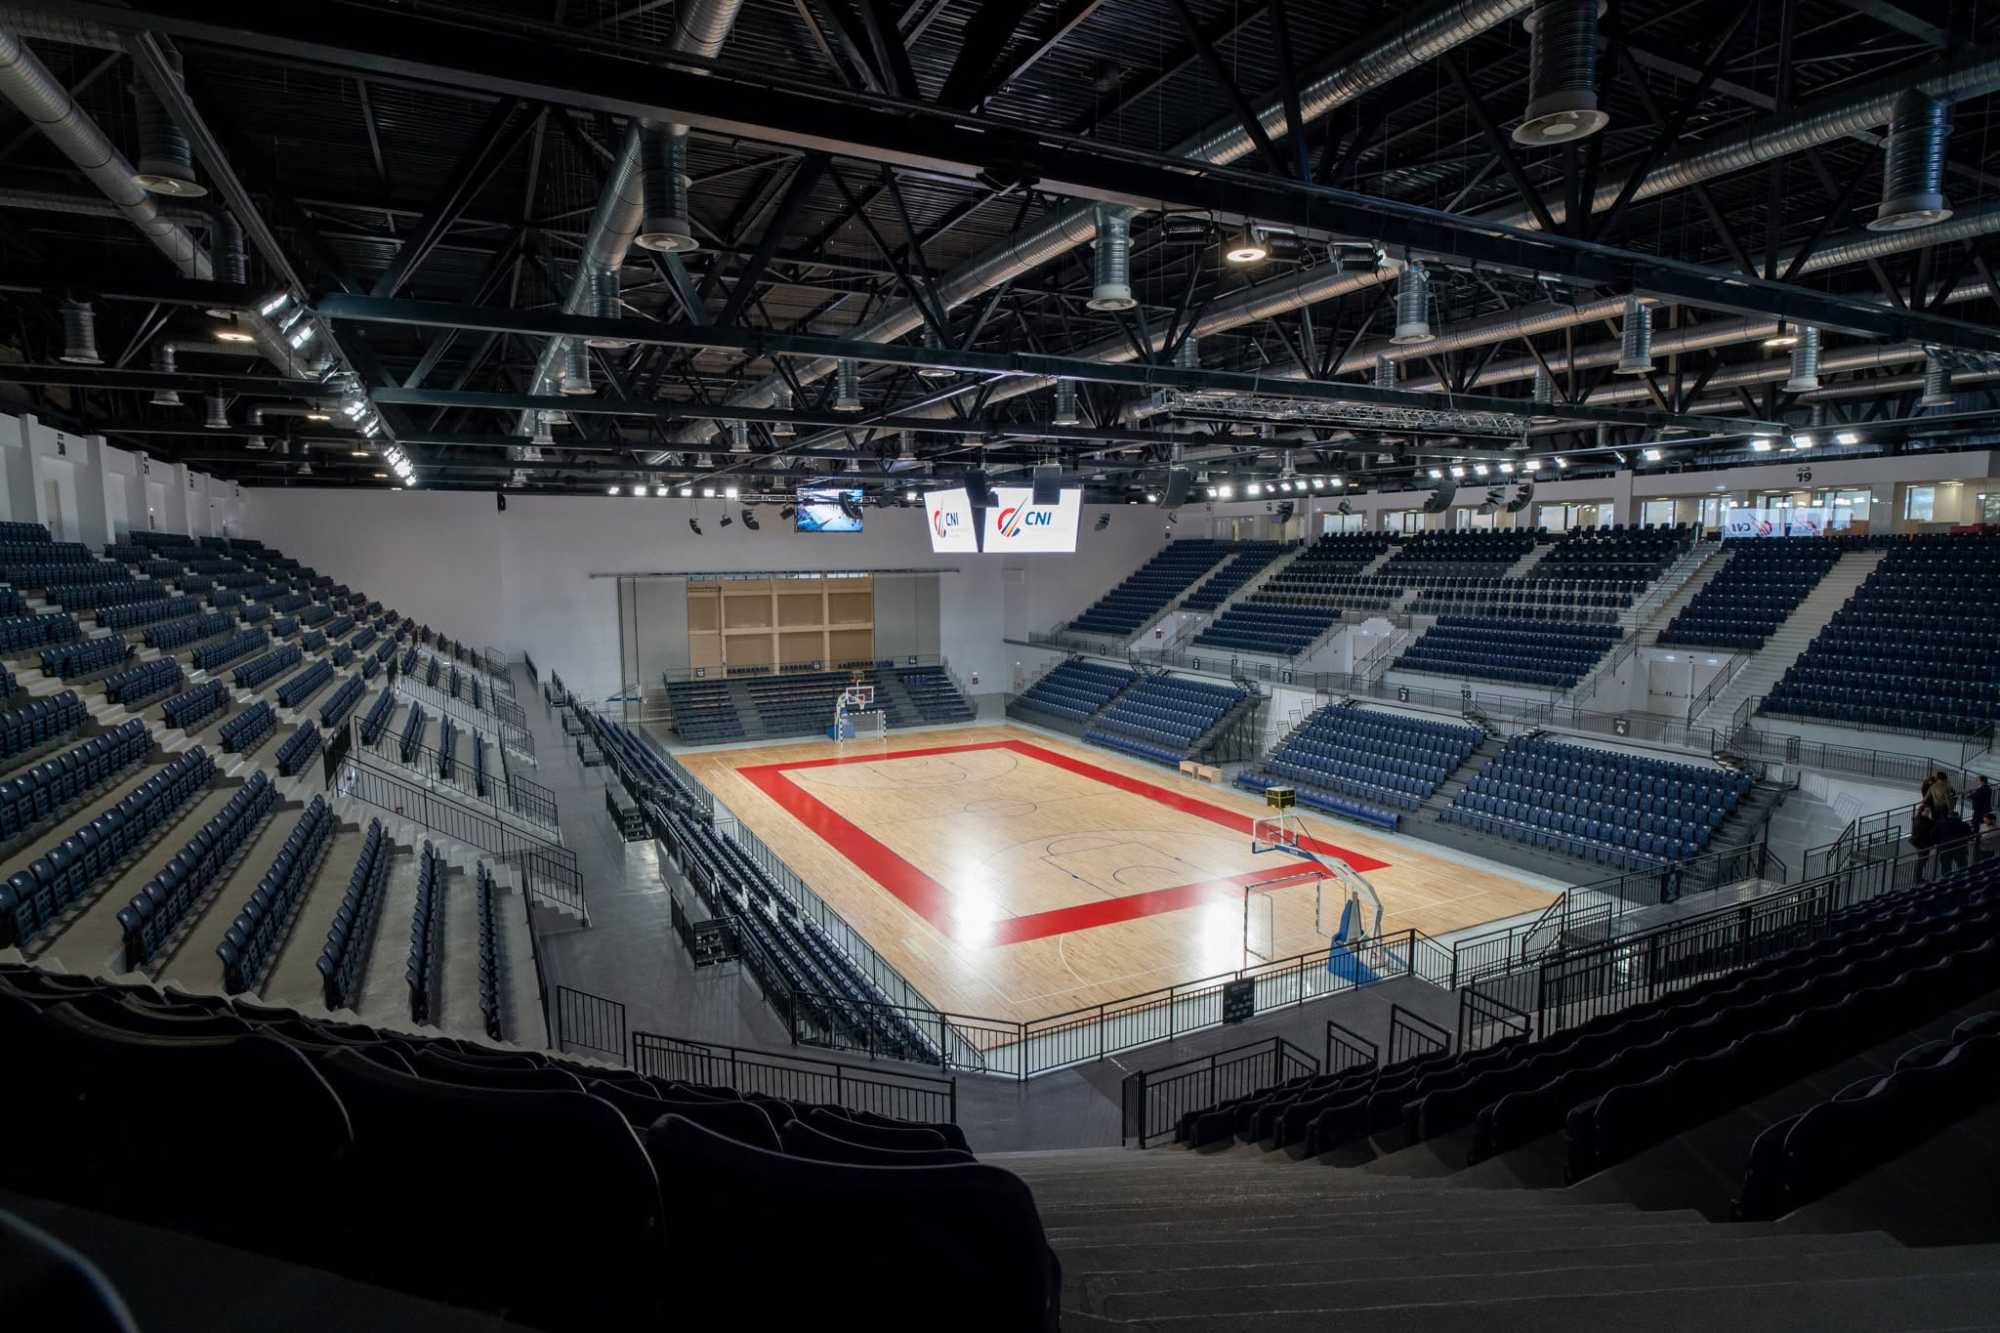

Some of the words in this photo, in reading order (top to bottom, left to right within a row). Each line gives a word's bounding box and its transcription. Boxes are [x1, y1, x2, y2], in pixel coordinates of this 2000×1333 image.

[1796, 472, 1812, 482] 19
[945, 511, 959, 527] CNI
[1025, 511, 1052, 526] CNI
